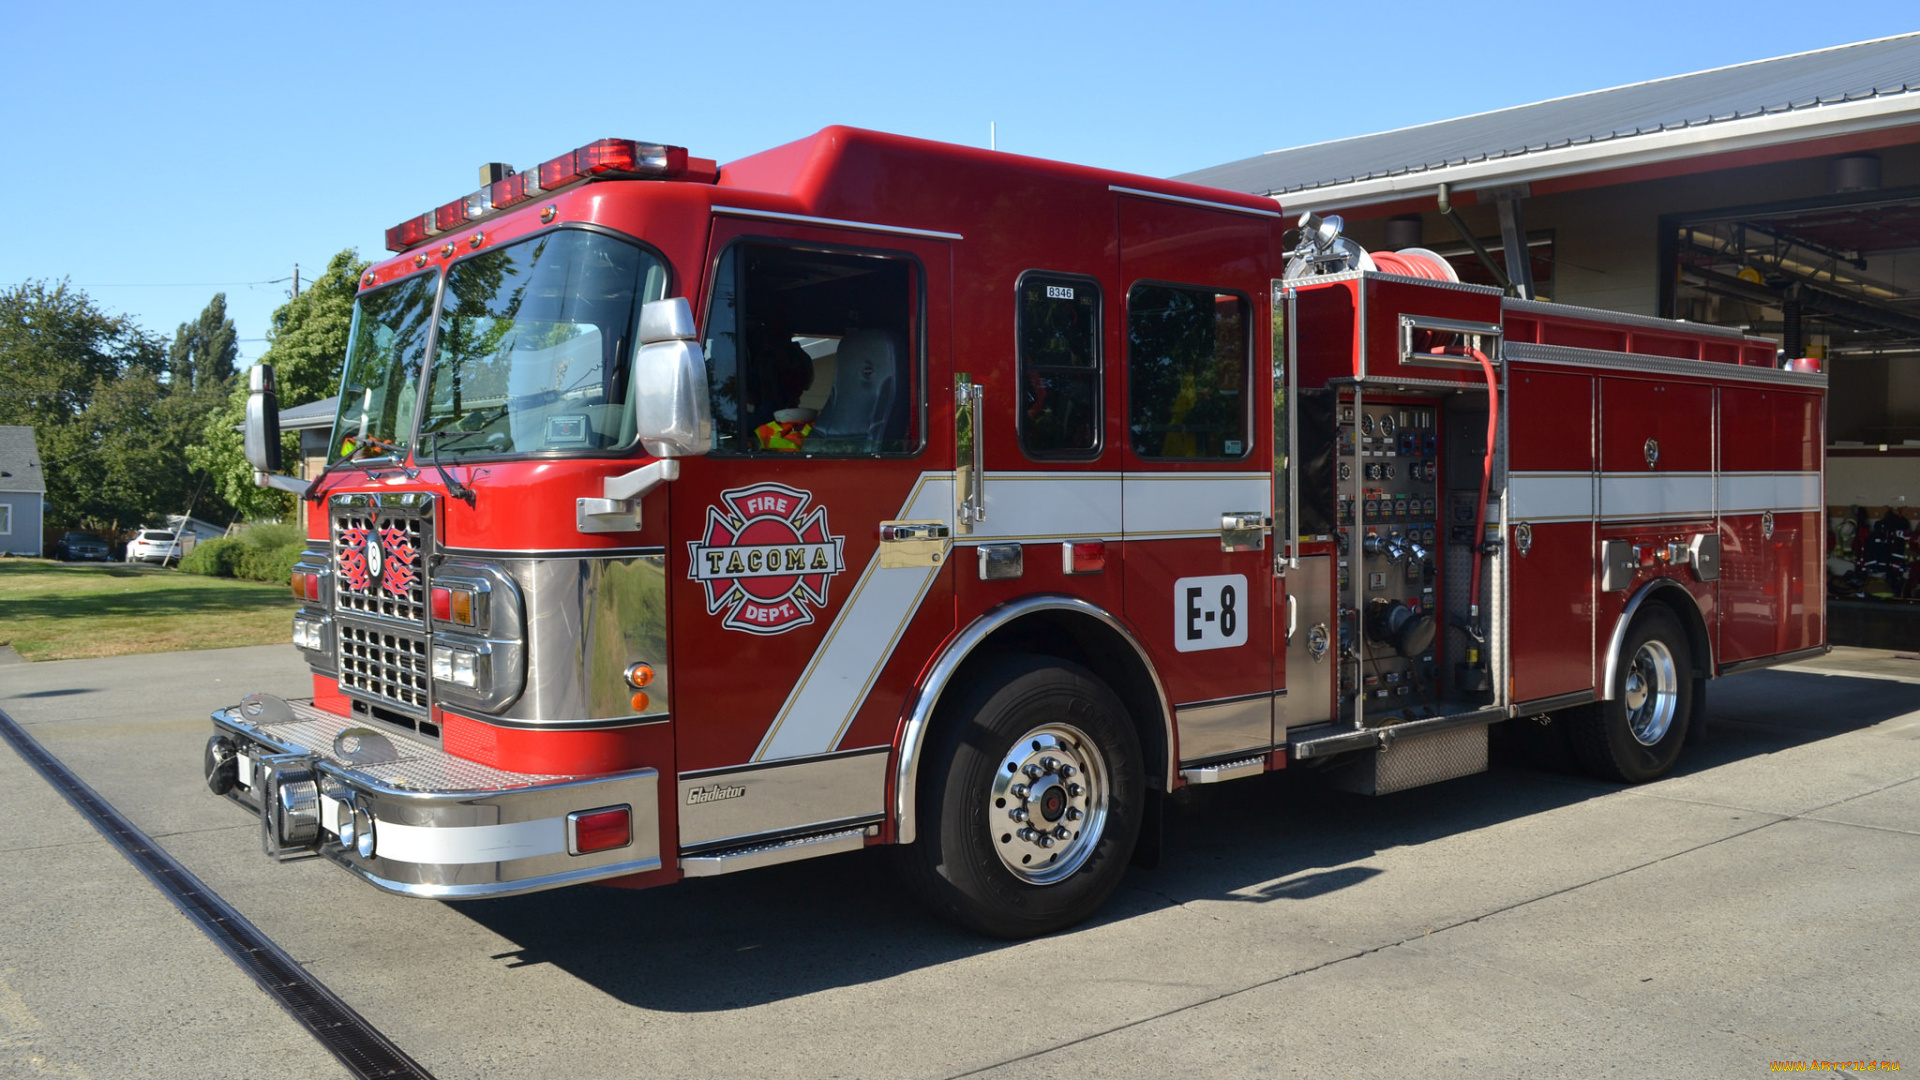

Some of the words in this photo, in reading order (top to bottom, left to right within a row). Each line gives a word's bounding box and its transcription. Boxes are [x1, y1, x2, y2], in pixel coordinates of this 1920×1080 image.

[1049, 287, 1072, 298] 8346
[747, 496, 788, 514] FIRE
[706, 547, 828, 574] TACOMA
[745, 604, 795, 622] DEPT.
[1187, 585, 1236, 640] E-8
[686, 784, 746, 805] Gladiator
